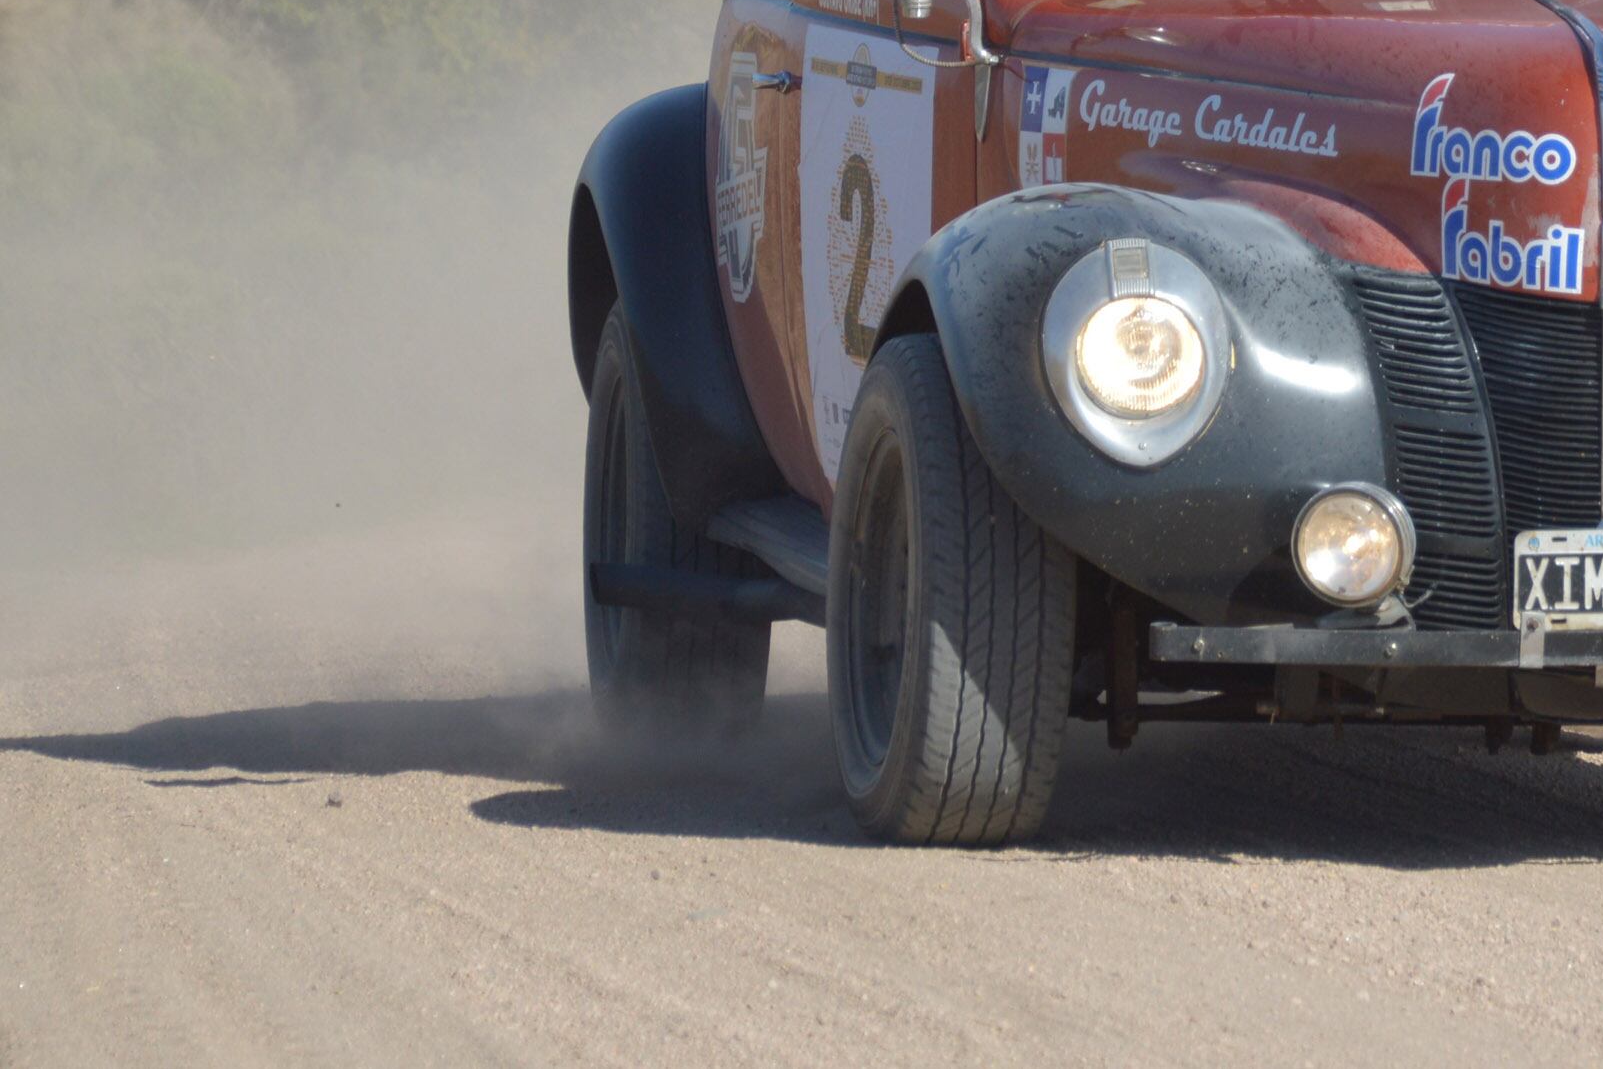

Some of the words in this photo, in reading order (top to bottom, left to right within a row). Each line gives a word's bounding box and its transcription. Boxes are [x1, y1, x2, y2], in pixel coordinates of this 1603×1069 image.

[1079, 79, 1182, 148] Garage
[1194, 94, 1338, 157] Cardales
[840, 153, 880, 363] 2
